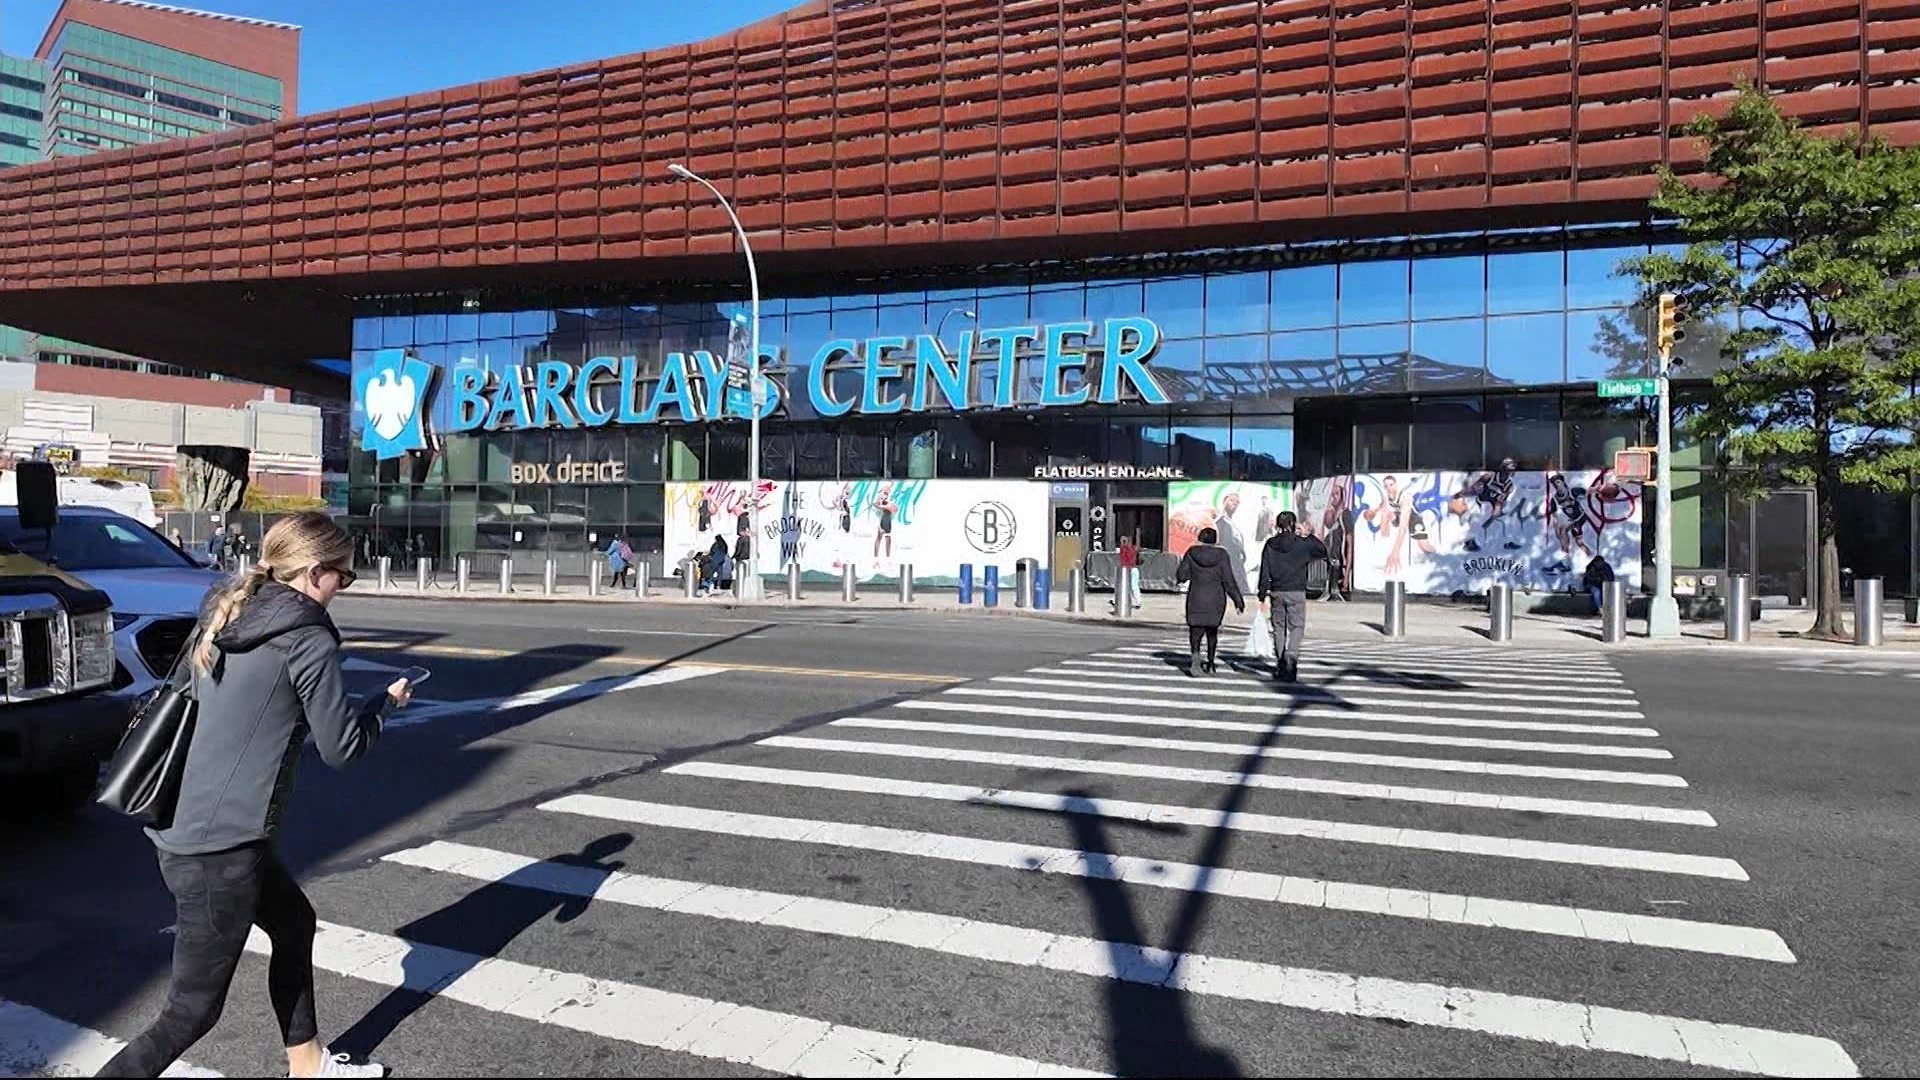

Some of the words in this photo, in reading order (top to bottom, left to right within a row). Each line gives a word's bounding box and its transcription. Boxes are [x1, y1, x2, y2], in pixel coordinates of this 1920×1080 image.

[808, 317, 1172, 417] CENTER
[1601, 381, 1642, 395] Flatbush
[511, 462, 551, 484] BOX
[556, 454, 625, 484] OFFICE
[1034, 466, 1105, 478] FLATBUSH
[1108, 466, 1184, 478] ENTRANCE
[784, 491, 805, 510] THE
[763, 515, 825, 540] BROOKLYN
[780, 541, 807, 560] WAY
[1463, 555, 1525, 576] BROOKLYN
